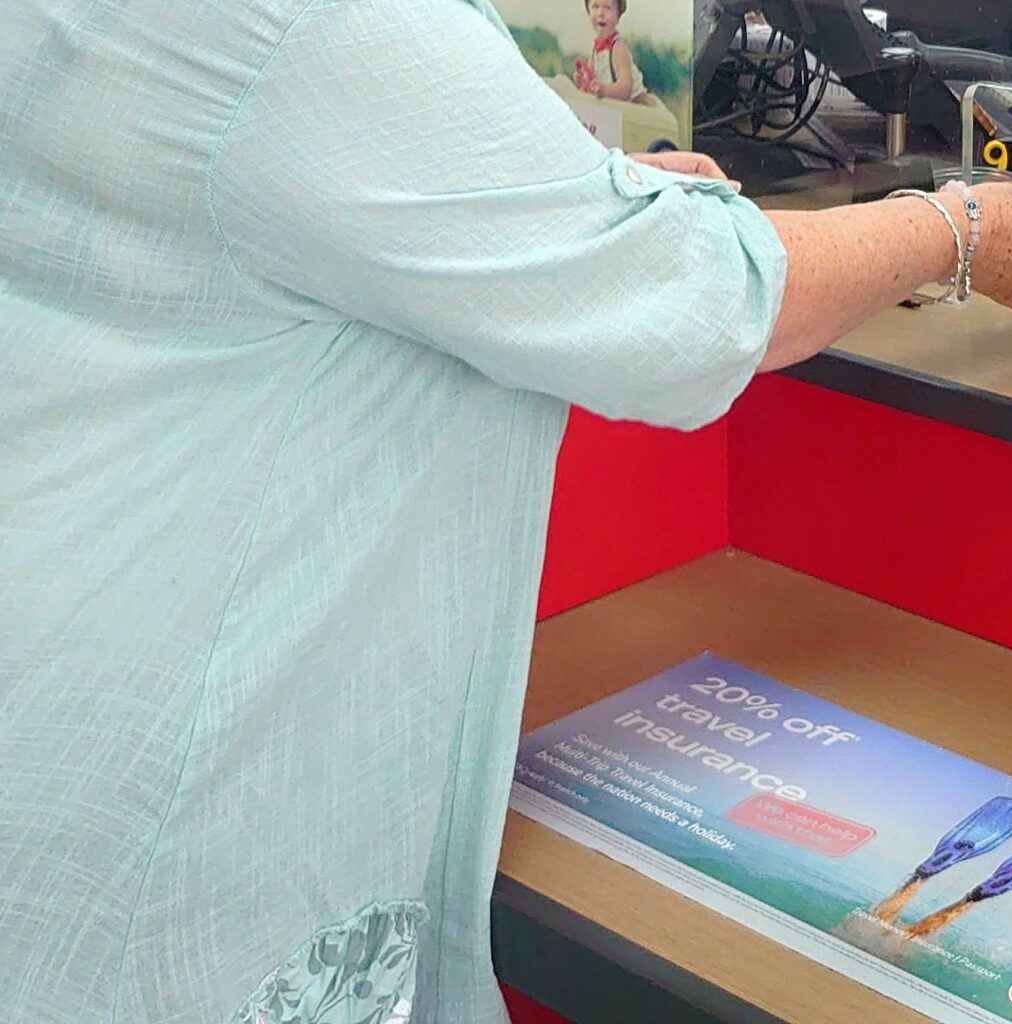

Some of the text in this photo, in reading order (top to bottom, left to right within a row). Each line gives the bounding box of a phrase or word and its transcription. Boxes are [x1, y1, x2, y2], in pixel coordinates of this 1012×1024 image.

[655, 693, 772, 747] travel
[690, 676, 779, 720] 20%
[554, 741, 610, 771] Multi-Trip
[610, 766, 649, 788] Travel
[572, 734, 698, 793] Save with our Annual
[613, 709, 807, 802] insurance
[535, 750, 584, 777] because
[582, 772, 605, 787] the
[602, 782, 642, 805] nation
[640, 800, 680, 823] needs
[677, 818, 689, 828] a
[687, 822, 737, 851] holiday.
[958, 956, 1001, 981] Passport
